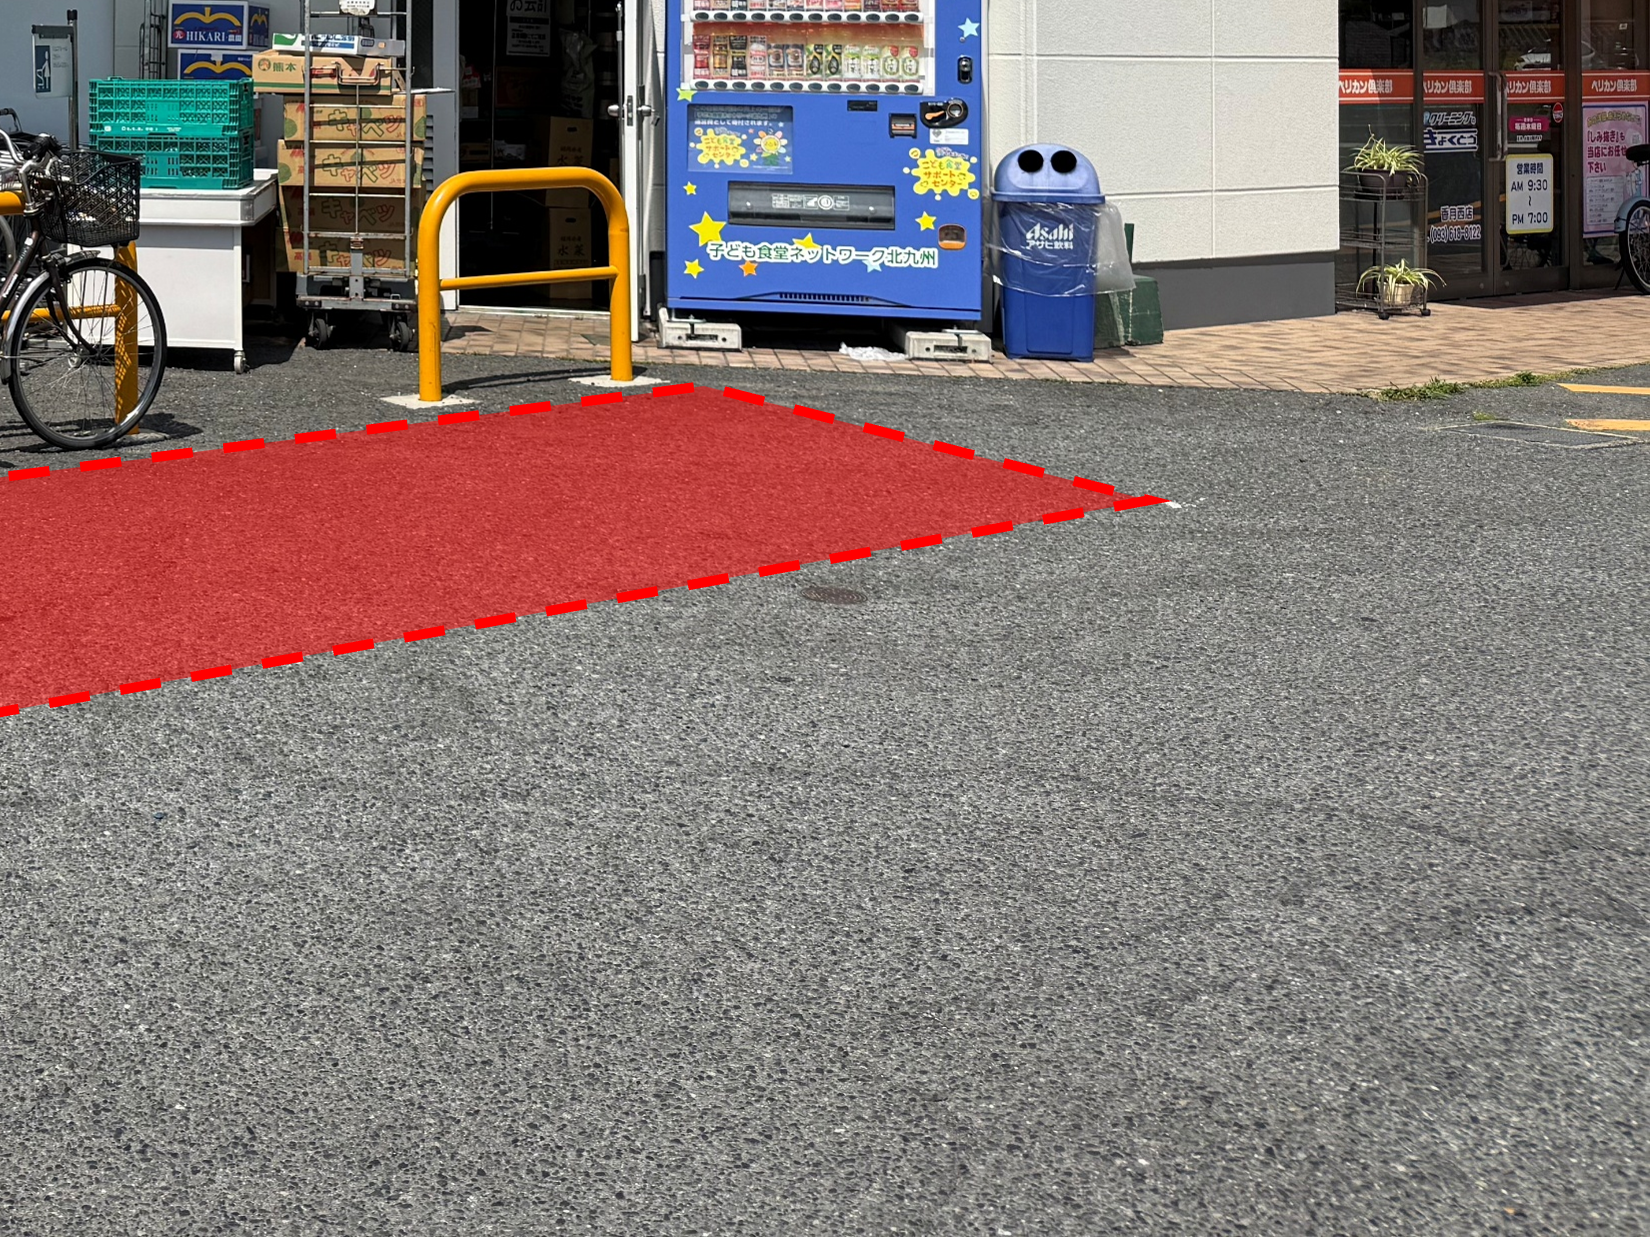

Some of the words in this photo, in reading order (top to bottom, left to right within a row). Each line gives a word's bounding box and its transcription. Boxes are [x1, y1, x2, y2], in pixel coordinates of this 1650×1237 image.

[186, 30, 226, 42] HIKARI
[272, 62, 297, 72] 熊本
[1591, 79, 1637, 93] ペリカン倶楽部
[1423, 127, 1477, 148] きょくとう
[1587, 146, 1627, 159] 当店にお任せ
[1516, 162, 1544, 175] 営業時間
[1587, 162, 1607, 173] 下さい
[923, 170, 956, 179] サポート
[932, 179, 962, 188] センター
[1511, 181, 1524, 192] AM
[1527, 179, 1548, 192] 9:30
[1440, 205, 1474, 222] 香月西店
[1512, 213, 1524, 224] PM
[1527, 211, 1548, 224] 7:00
[1026, 222, 1074, 241] Asahi
[1025, 240, 1074, 250] アサヒ飲料
[707, 242, 937, 267] 子ども食堂ネットワーク北九州
